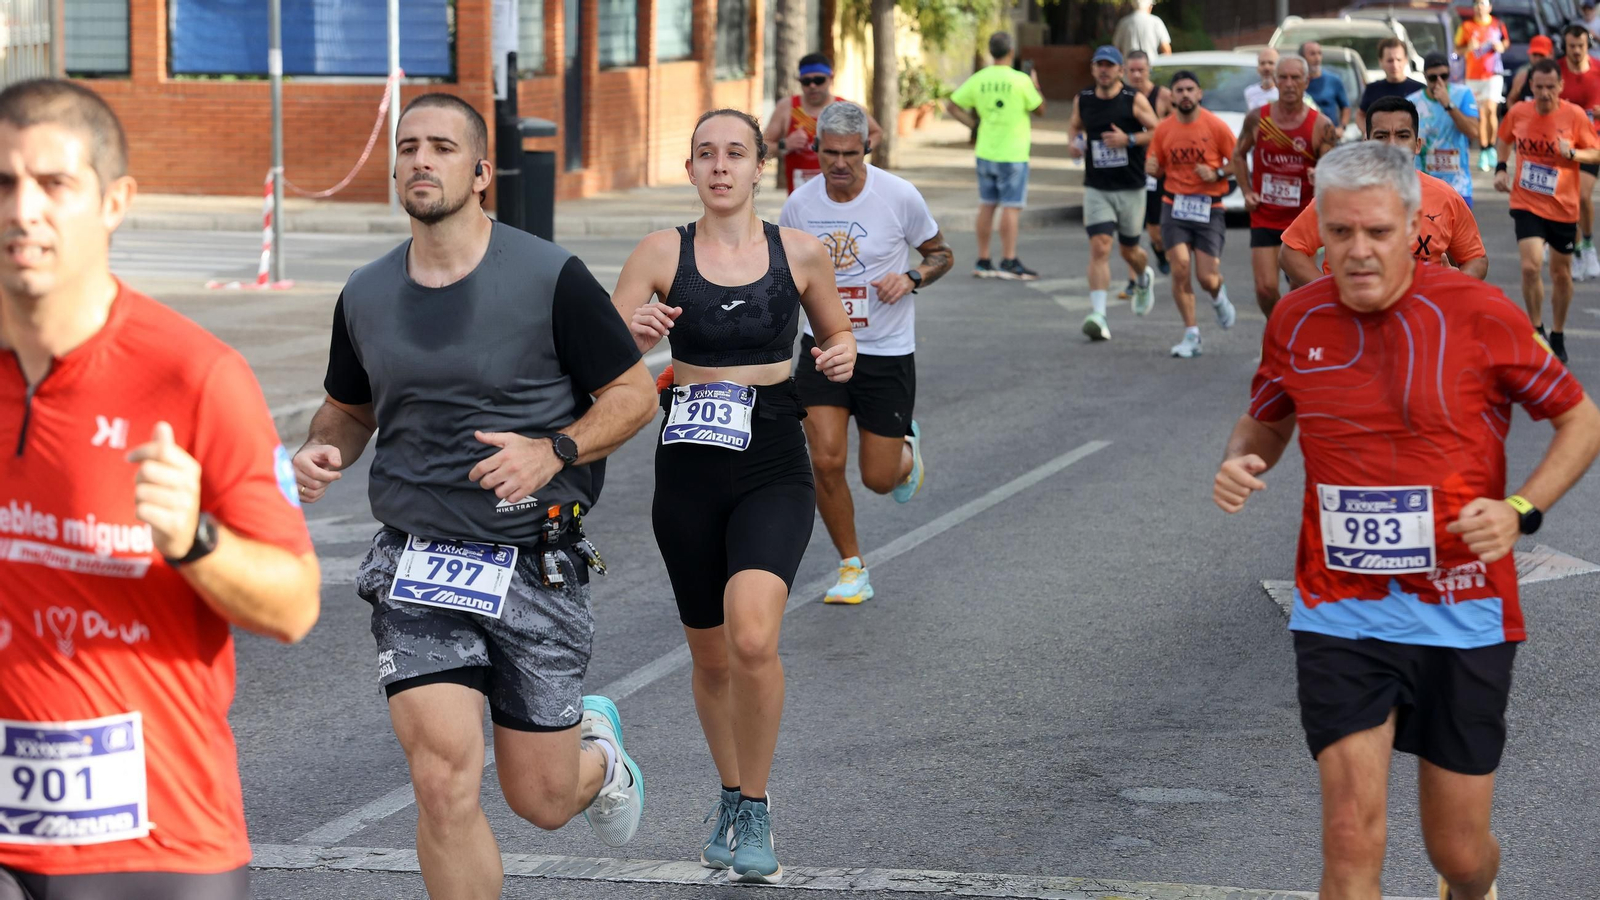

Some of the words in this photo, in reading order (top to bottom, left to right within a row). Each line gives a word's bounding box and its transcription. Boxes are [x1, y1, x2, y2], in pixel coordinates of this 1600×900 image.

[1170, 148, 1206, 163] XXIX
[687, 401, 733, 425] 903
[516, 502, 538, 510] TRAIL
[1344, 518, 1402, 545] 983
[426, 556, 484, 586] 797
[13, 766, 92, 802] 901
